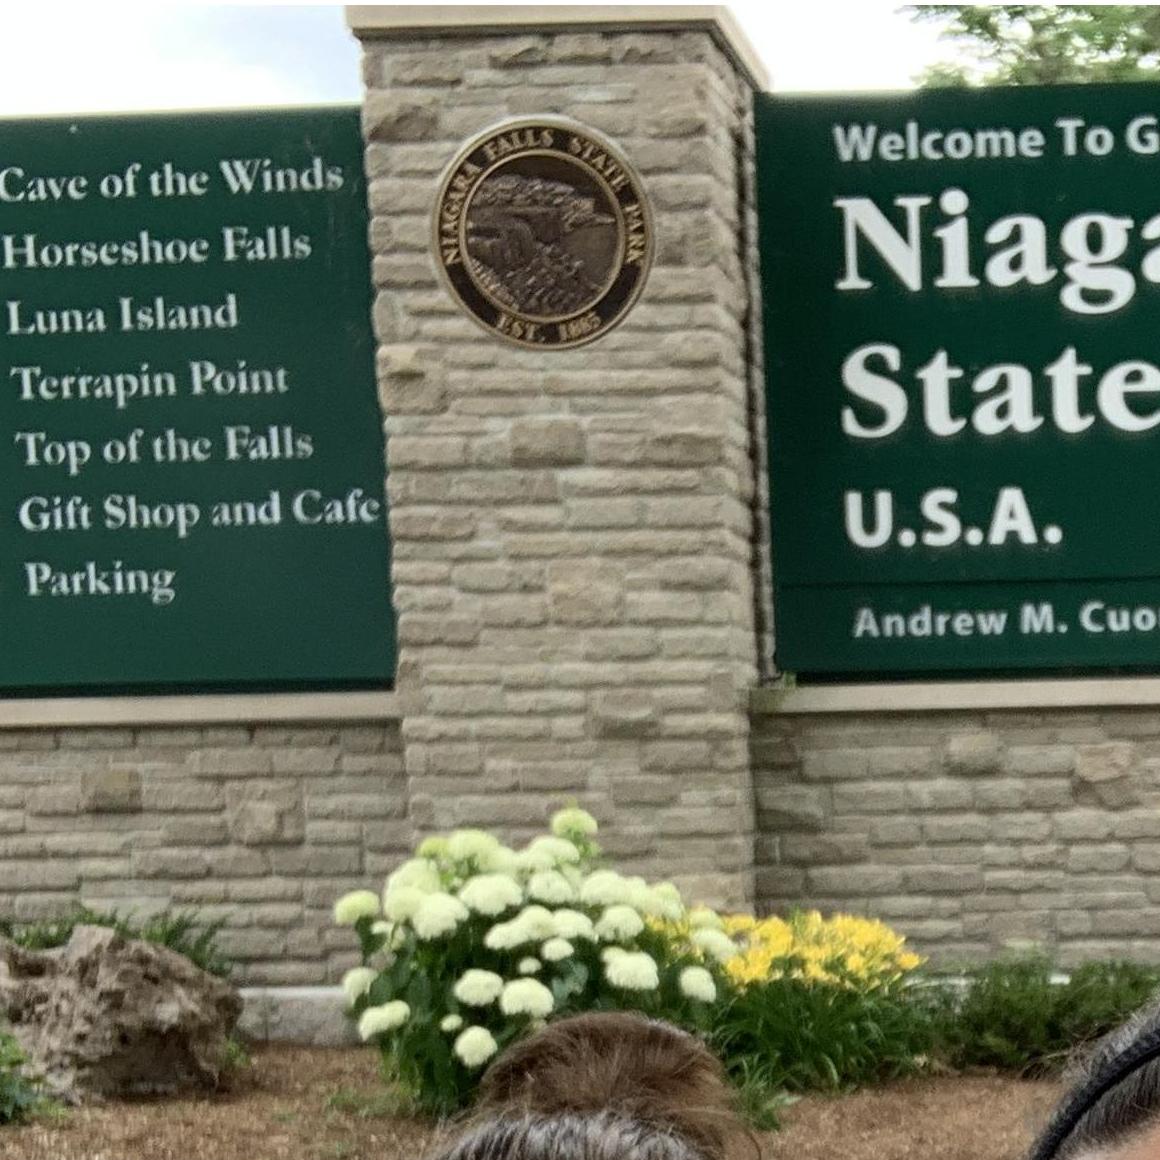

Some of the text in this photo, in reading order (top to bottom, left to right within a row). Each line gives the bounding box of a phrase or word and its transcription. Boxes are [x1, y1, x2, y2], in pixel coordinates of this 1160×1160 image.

[832, 120, 1045, 162] Welcome
[1054, 117, 1115, 157] To
[0, 156, 346, 203] Cave of the Winds
[483, 129, 554, 161] FALLS
[567, 136, 631, 195] STATE
[623, 203, 645, 264] PARK
[2, 226, 314, 269] Horseshoe Falls
[6, 293, 239, 335] Luna Island
[9, 359, 289, 410] Terrapin Point
[14, 425, 315, 476] Top of the Falls
[18, 487, 381, 539] Gift Shop and Cafe
[844, 485, 1064, 550] U.S.A.
[24, 559, 177, 605] Parking
[853, 605, 1008, 639] Andrew
[1019, 602, 1069, 635] M.
